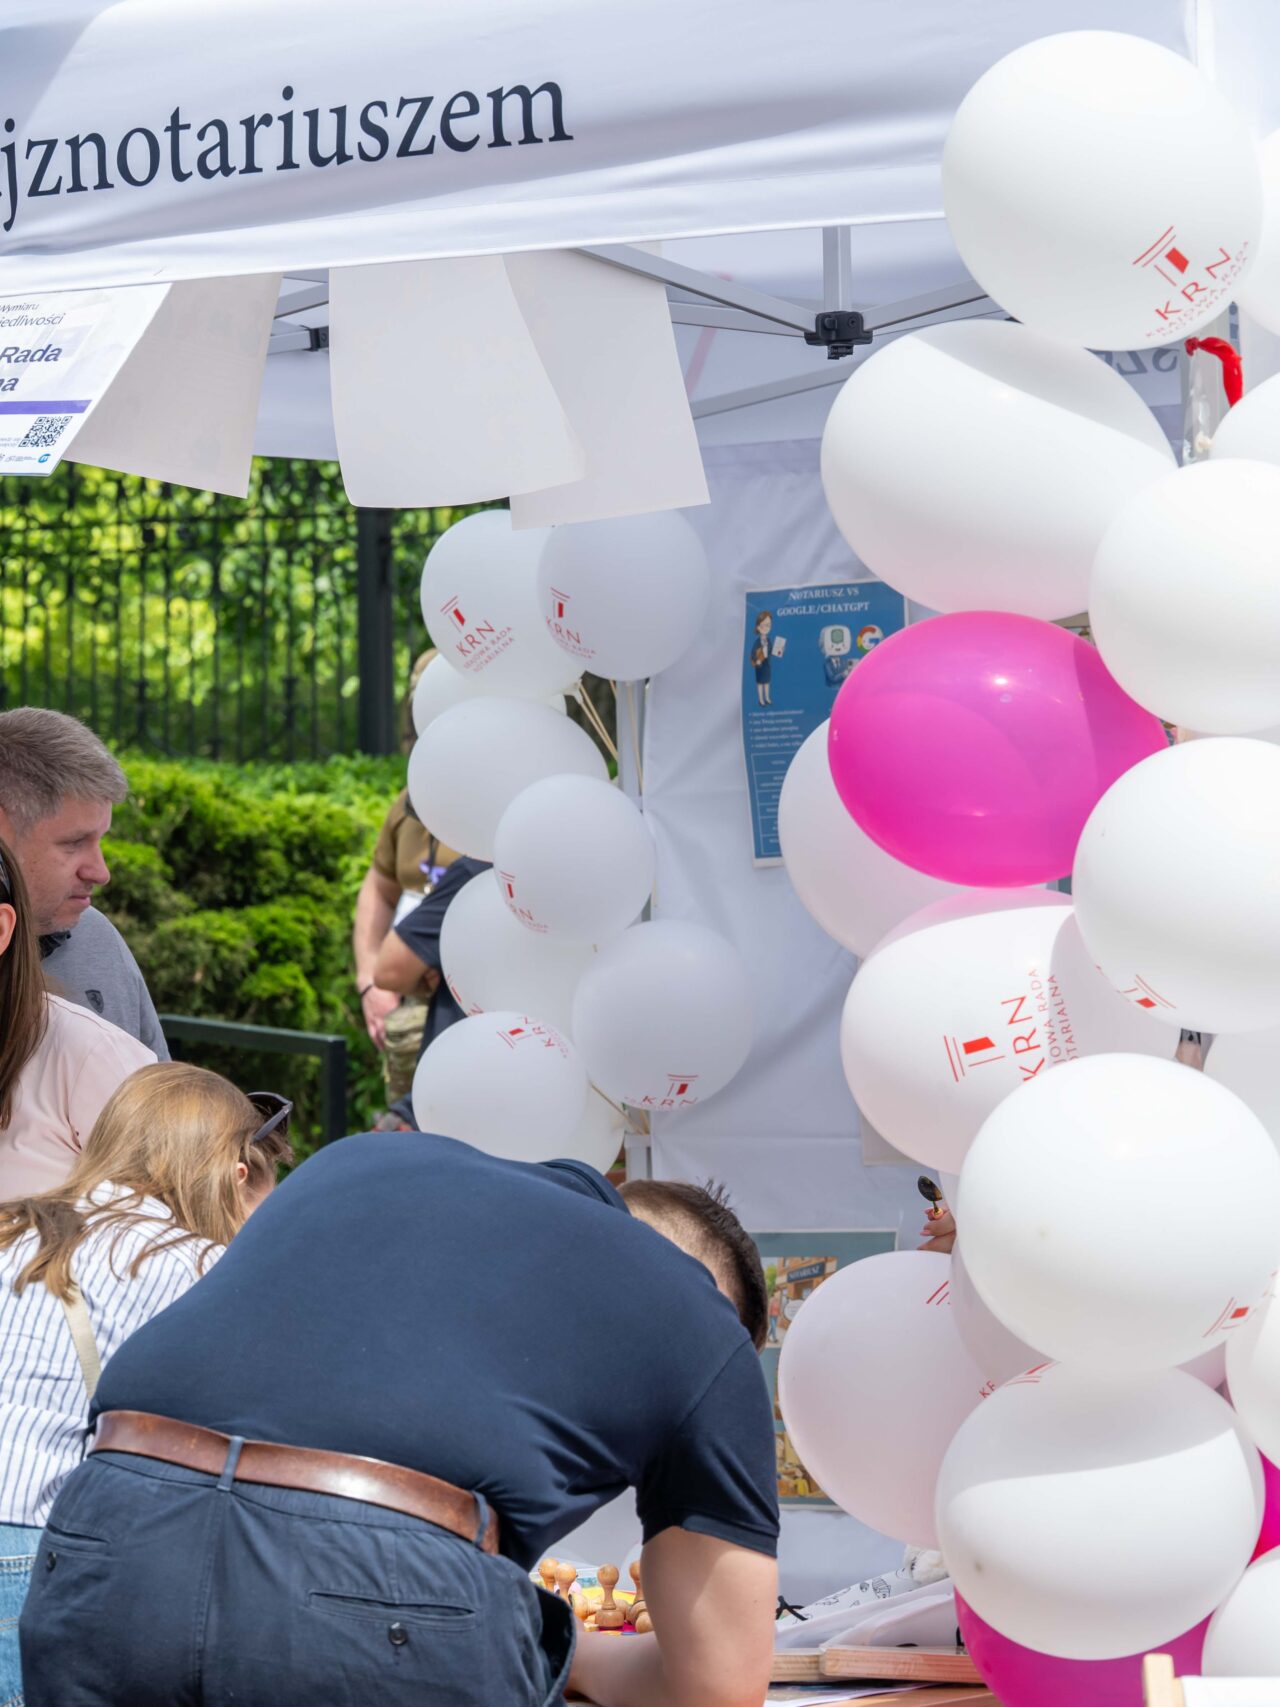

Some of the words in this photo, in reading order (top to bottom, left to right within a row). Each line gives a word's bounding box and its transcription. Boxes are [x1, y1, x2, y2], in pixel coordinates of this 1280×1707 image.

[1154, 247, 1231, 321] KRN
[776, 601, 871, 617] GOOGLE/CHATGPT
[788, 587, 845, 600] NOTARIUSZ
[455, 620, 496, 657] KRN
[1000, 996, 1046, 1082] KRN
